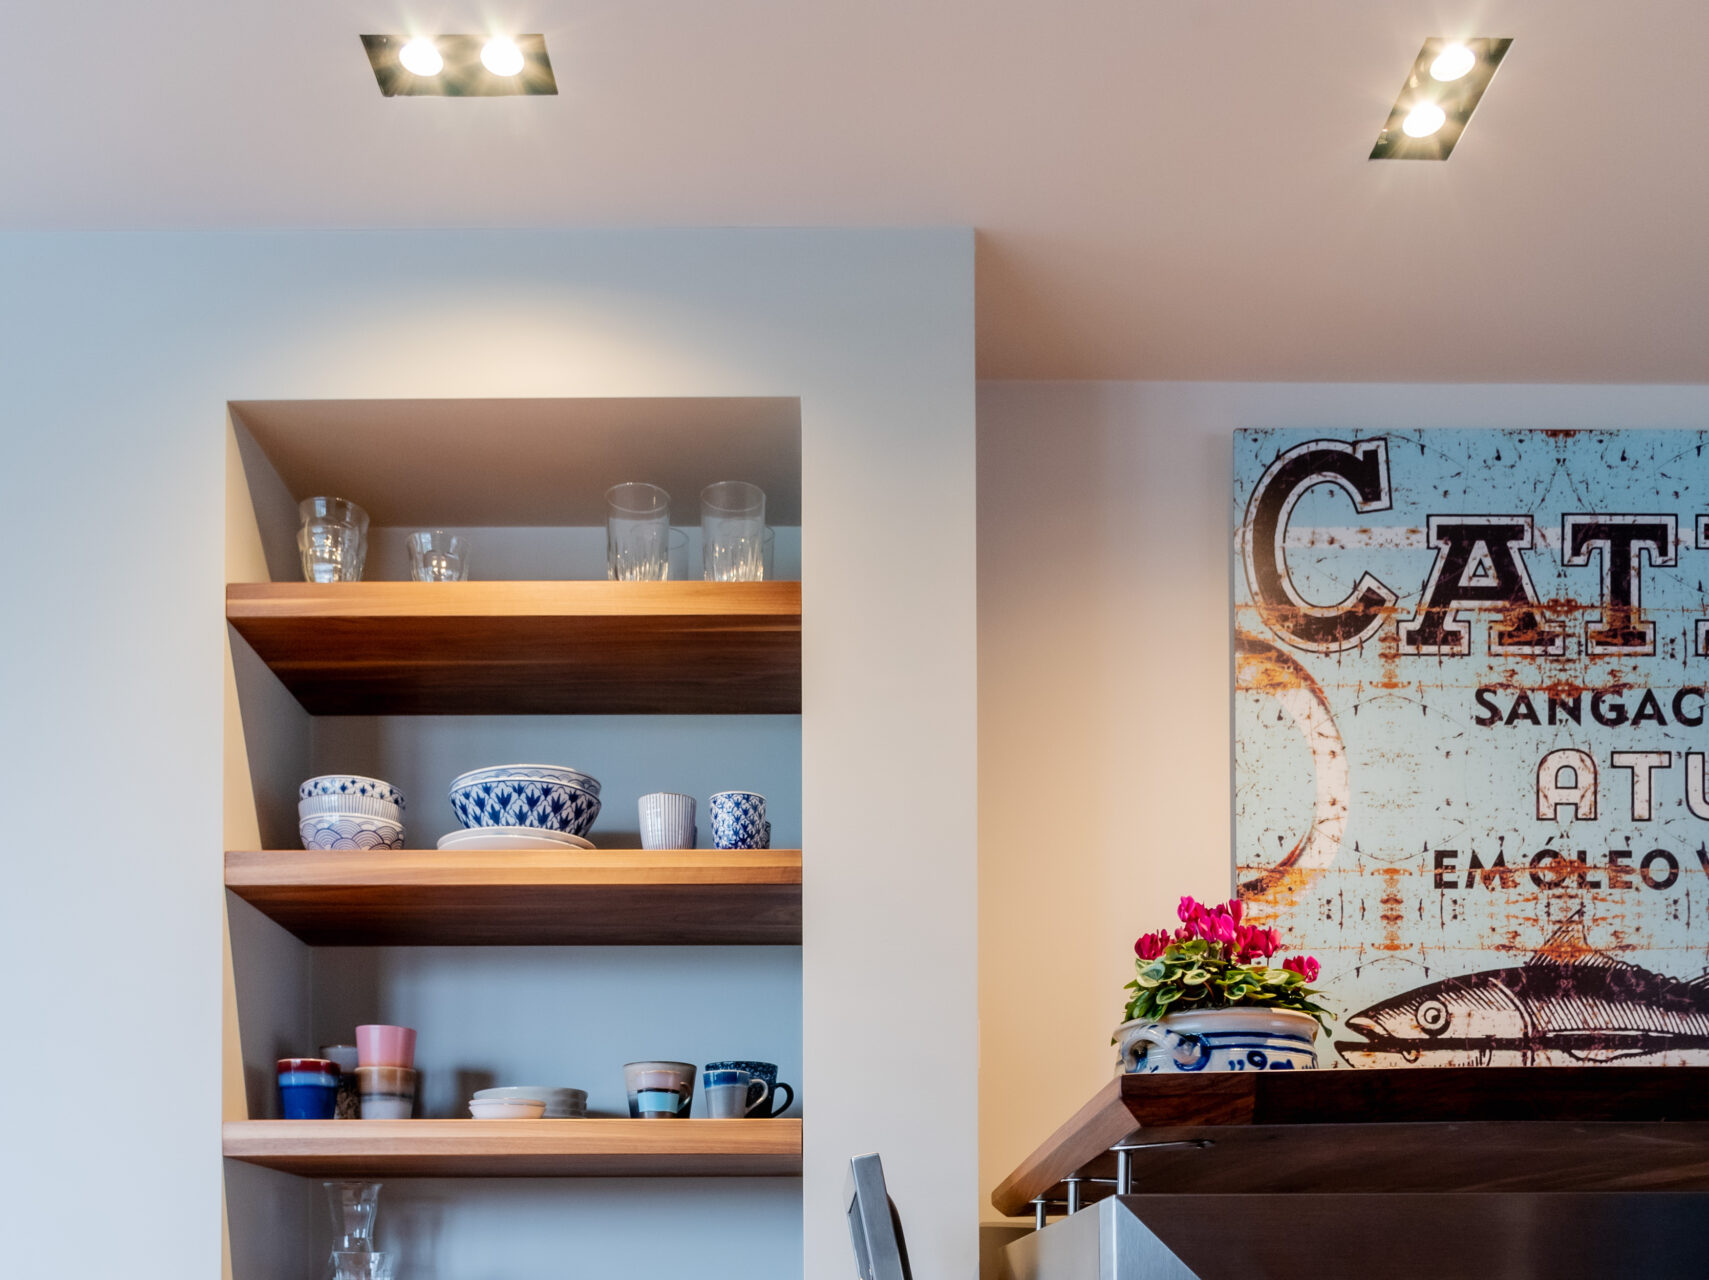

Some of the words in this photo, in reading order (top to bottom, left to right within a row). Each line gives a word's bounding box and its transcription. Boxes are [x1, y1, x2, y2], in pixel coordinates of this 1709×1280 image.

[1243, 436, 1709, 656] CAT
[1434, 849, 1513, 890] EM
[1529, 836, 1679, 890] ÓLEO
